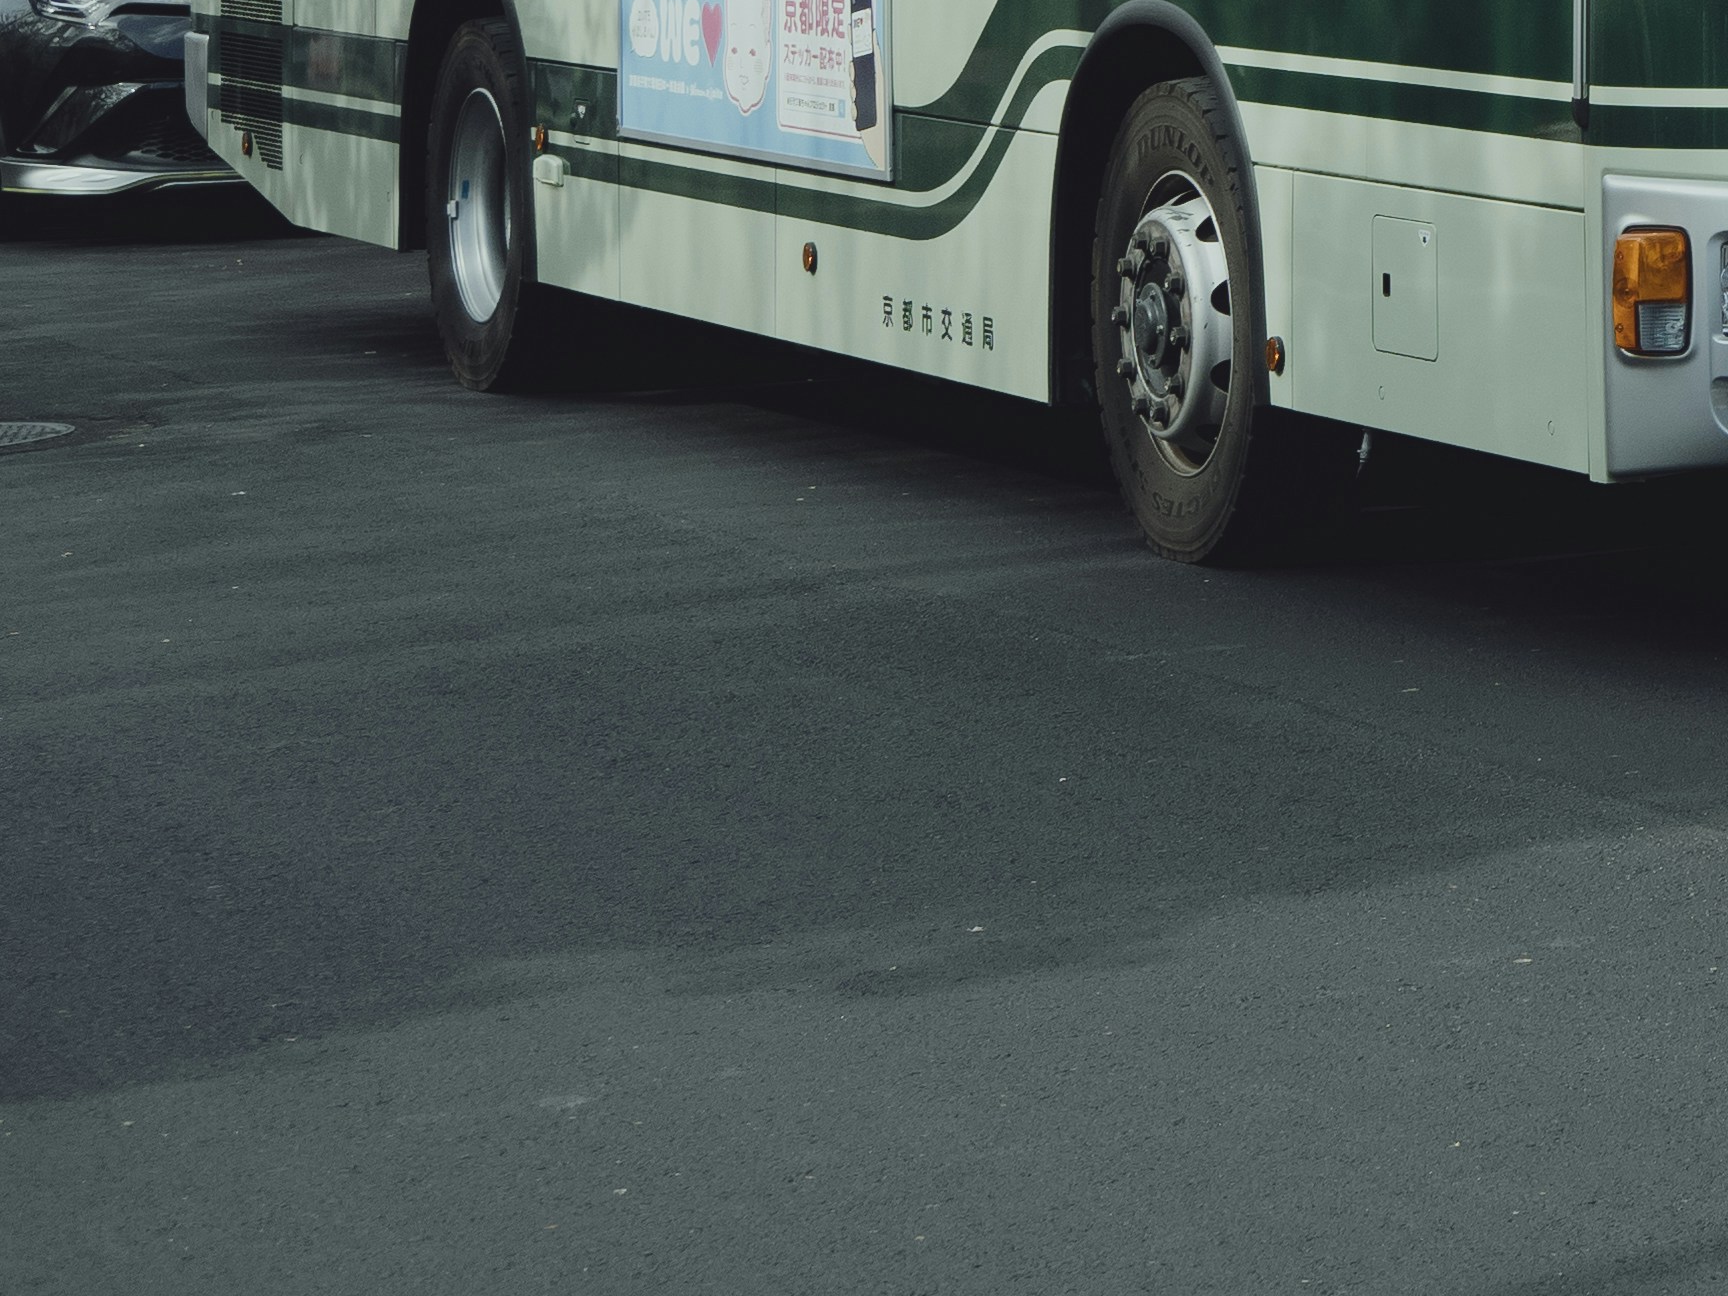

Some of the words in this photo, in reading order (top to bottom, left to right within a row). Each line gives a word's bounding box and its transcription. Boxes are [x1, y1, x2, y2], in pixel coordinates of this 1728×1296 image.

[882, 295, 994, 351] 京都市交通局
